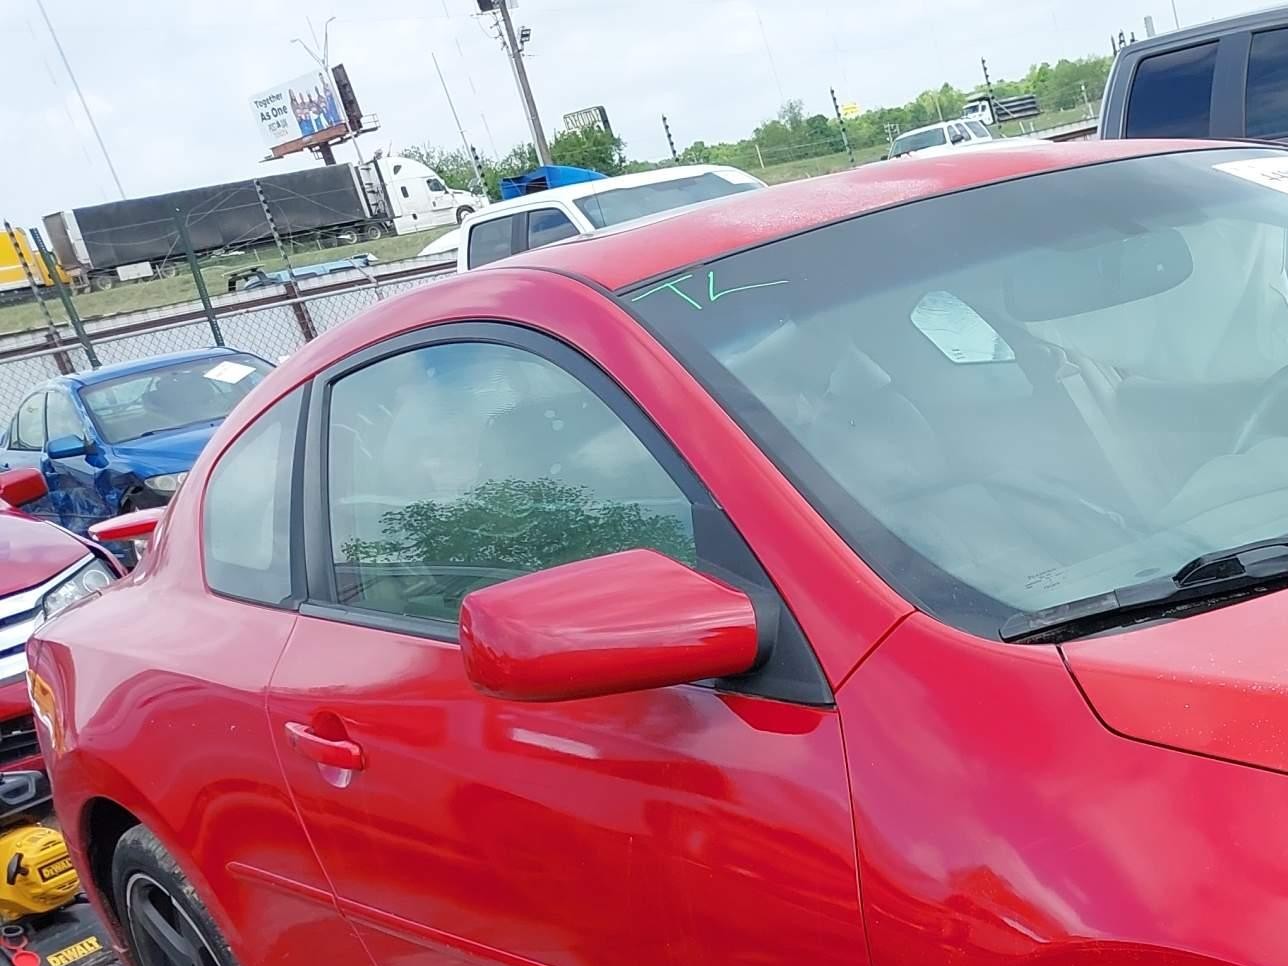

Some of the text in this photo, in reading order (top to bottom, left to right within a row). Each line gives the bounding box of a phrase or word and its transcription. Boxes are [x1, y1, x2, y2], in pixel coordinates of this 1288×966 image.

[254, 92, 284, 109] Together
[260, 104, 289, 123] As One
[42, 857, 72, 879] DEWAL
